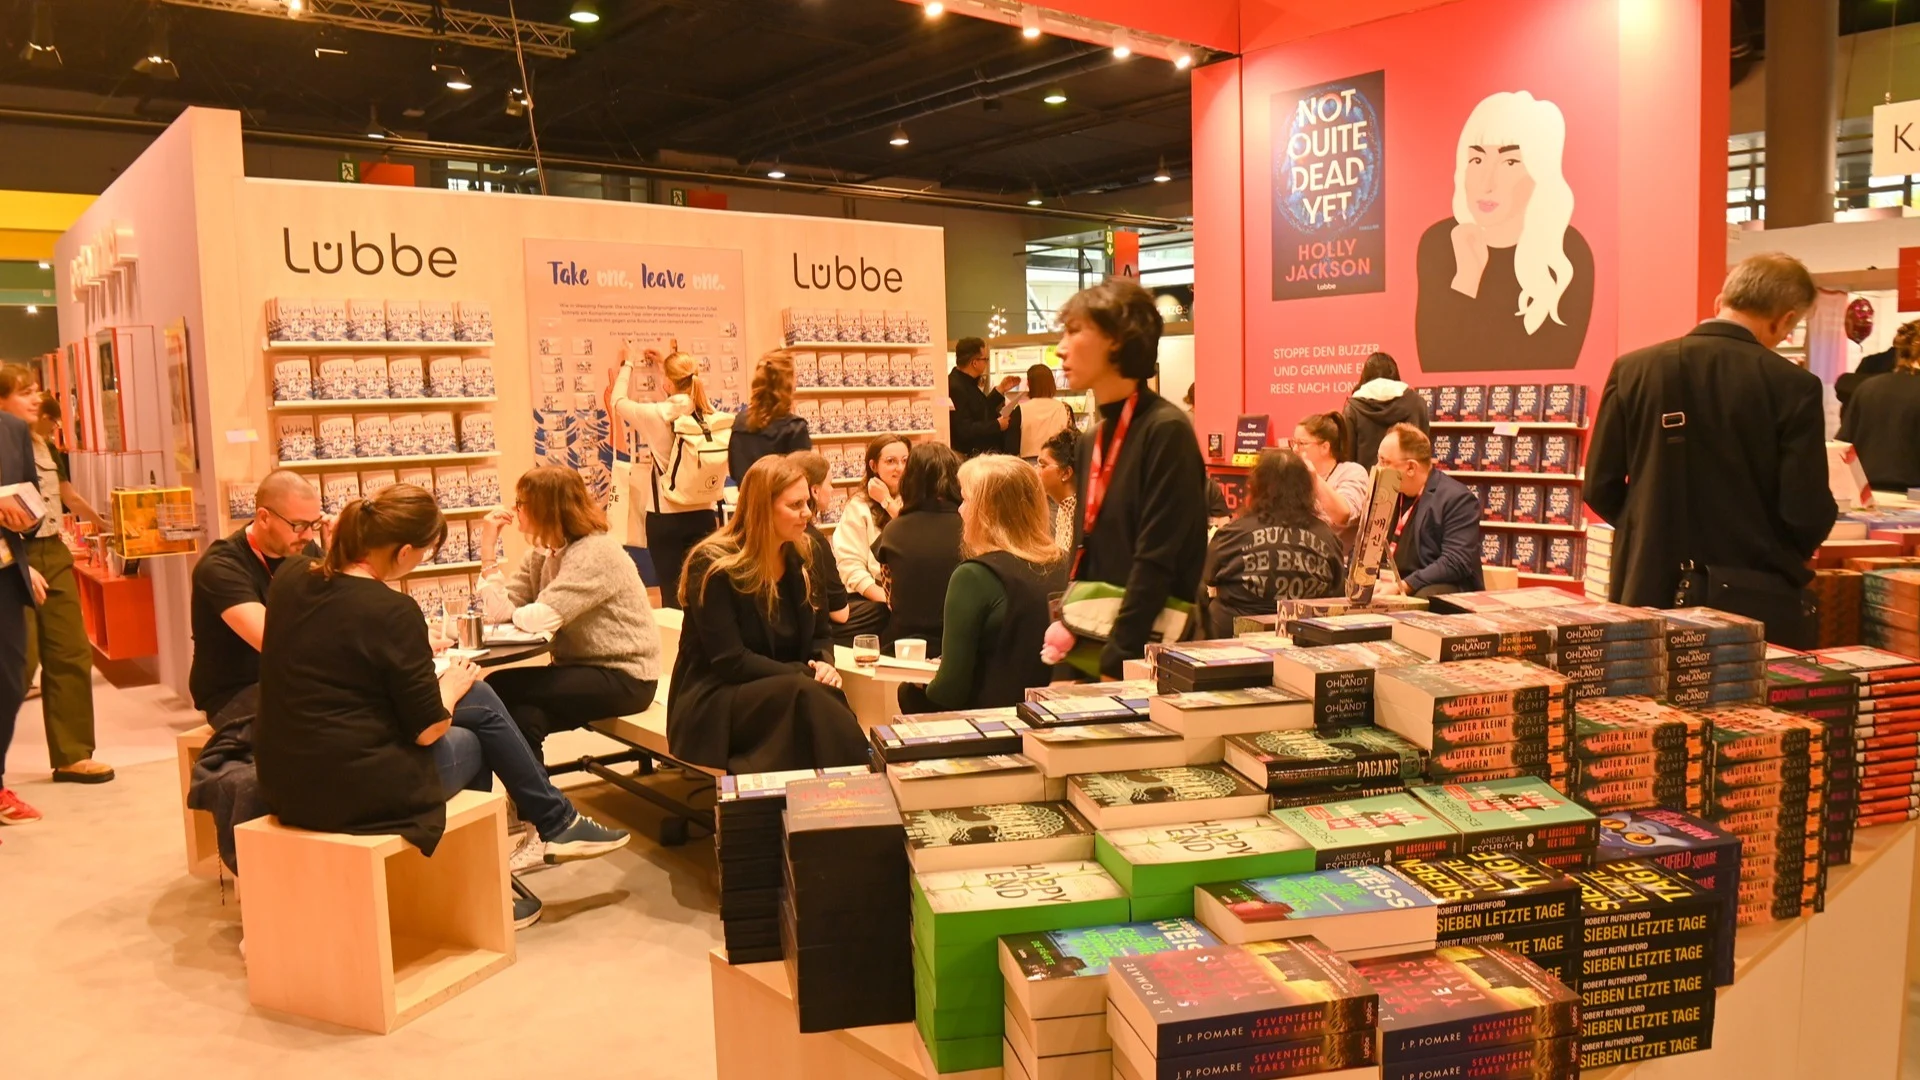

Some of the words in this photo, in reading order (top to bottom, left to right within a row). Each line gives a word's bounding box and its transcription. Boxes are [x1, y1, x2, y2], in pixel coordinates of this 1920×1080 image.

[1298, 88, 1357, 127] NOT
[1287, 121, 1368, 160] QUITE
[1291, 157, 1365, 193] DEAD
[1302, 191, 1352, 225] YET
[1298, 238, 1357, 261] HOLLY
[547, 261, 589, 286] Take
[597, 269, 634, 289] one,
[641, 263, 686, 289] leave
[692, 272, 726, 291] one.
[1285, 257, 1370, 282] JACKSON
[1273, 347, 1309, 359] STOPPE
[1313, 346, 1335, 357] DEN
[1338, 343, 1379, 356] BUZZER
[1274, 365, 1298, 377] UND
[1301, 363, 1352, 376] GEWINNE
[1270, 383, 1295, 395] REISE
[1298, 382, 1330, 393] NACH
[1242, 551, 1270, 572] BE
[1276, 550, 1330, 577] BACK
[1241, 575, 1268, 598] IN
[1566, 629, 1604, 639] OHLANDT
[1671, 633, 1706, 644] OHLANDT
[1451, 641, 1492, 652] OHLANDT
[1565, 649, 1604, 659] OHLANDT
[1676, 652, 1711, 663] OHLANDT
[1567, 668, 1605, 679] OHLANDT
[1326, 677, 1368, 688] OHLANDT
[1520, 691, 1544, 700] KATE
[1576, 687, 1607, 697] HLANDT
[1325, 701, 1367, 713] OHLANDT
[1448, 696, 1478, 708] LAUTER
[1481, 694, 1508, 705] KLEINE
[1518, 700, 1545, 711] KEMP
[1464, 707, 1490, 717] LÜGEN
[1519, 715, 1544, 725] KATE
[1448, 721, 1477, 733] LAUTER
[1481, 719, 1507, 729] KLEINE
[1518, 726, 1545, 736] KEMP
[1464, 732, 1490, 742] LÜGEN
[1592, 733, 1618, 743] LAUTER
[1622, 731, 1648, 740] KLEINE
[1728, 739, 1752, 750] LAUTER
[1755, 735, 1776, 745] KLEINE
[1607, 743, 1631, 753] LÜGEN
[1745, 749, 1762, 759] LÜGEN
[1330, 768, 1354, 777] HENRY
[1357, 759, 1399, 778] PAGANS
[1165, 829, 1214, 853] END
[1187, 819, 1259, 855] HAPPY
[1481, 834, 1515, 844] ANDREAS
[1335, 851, 1371, 862] ANDREAS
[1693, 851, 1717, 869] SQUARE
[985, 872, 1029, 899] END
[1013, 863, 1072, 903] HAPPY
[1339, 868, 1415, 908] WEISS
[1437, 905, 1462, 915] ROBERT
[1463, 900, 1506, 912] RUTHERFORD
[1437, 914, 1481, 932] SIEBEN
[1485, 907, 1531, 926] LETZTE
[1535, 903, 1565, 920] TAGE
[1585, 916, 1609, 926] ROBERT
[1610, 911, 1651, 923] RUTHERFORD
[1584, 924, 1627, 942] SIEBEN
[1631, 919, 1673, 937] LETZTE
[1677, 915, 1706, 931] TAGE
[1462, 933, 1504, 945] RUTHERFORD
[1533, 935, 1564, 952] TAGE
[1583, 947, 1607, 958] ROBERT
[1608, 942, 1648, 954] RUTHERFORD
[1583, 956, 1625, 974] SIEBEN
[1629, 949, 1671, 968] LETZTE
[1675, 945, 1703, 961] TAGE
[1122, 963, 1158, 995] POMARE
[1582, 980, 1606, 990] ROBERT
[1607, 974, 1647, 986] RUTHERFORD
[1582, 987, 1624, 1006] SIEBEN
[1628, 981, 1670, 1000] LETZTE
[1673, 976, 1702, 992] TAGE
[1605, 1004, 1645, 1016] RUTHERFORD
[1256, 1011, 1322, 1027] SEVENTEEN
[1472, 1015, 1532, 1033] SEVENTEEN
[1582, 1018, 1622, 1037] SIEBEN
[1627, 1012, 1668, 1031] LETZTE
[1672, 1007, 1700, 1023] TAGE
[1187, 1034, 1193, 1042] P.
[1197, 1026, 1244, 1041] POMARE
[1251, 1027, 1287, 1038] YEARS
[1294, 1021, 1327, 1033] LATER
[1467, 1033, 1501, 1044] YEARS
[1507, 1026, 1536, 1037] LATER
[1410, 1040, 1416, 1048] P.
[1419, 1032, 1461, 1046] POMARE
[1605, 1035, 1644, 1047] RUTHERFORD
[1254, 1045, 1321, 1063] SEVENTEEN
[1472, 1050, 1532, 1067] SEVENTEEN
[1580, 1049, 1621, 1068] SIEBEN
[1625, 1042, 1667, 1061] LETZTE
[1670, 1036, 1697, 1053] TAGE
[1196, 1062, 1242, 1077] POMARE
[1249, 1062, 1285, 1074] YEARS
[1292, 1056, 1325, 1068] LATER
[1419, 1066, 1461, 1080] POMARE
[1467, 1067, 1500, 1077] YEARS
[1506, 1060, 1535, 1072] LATER
